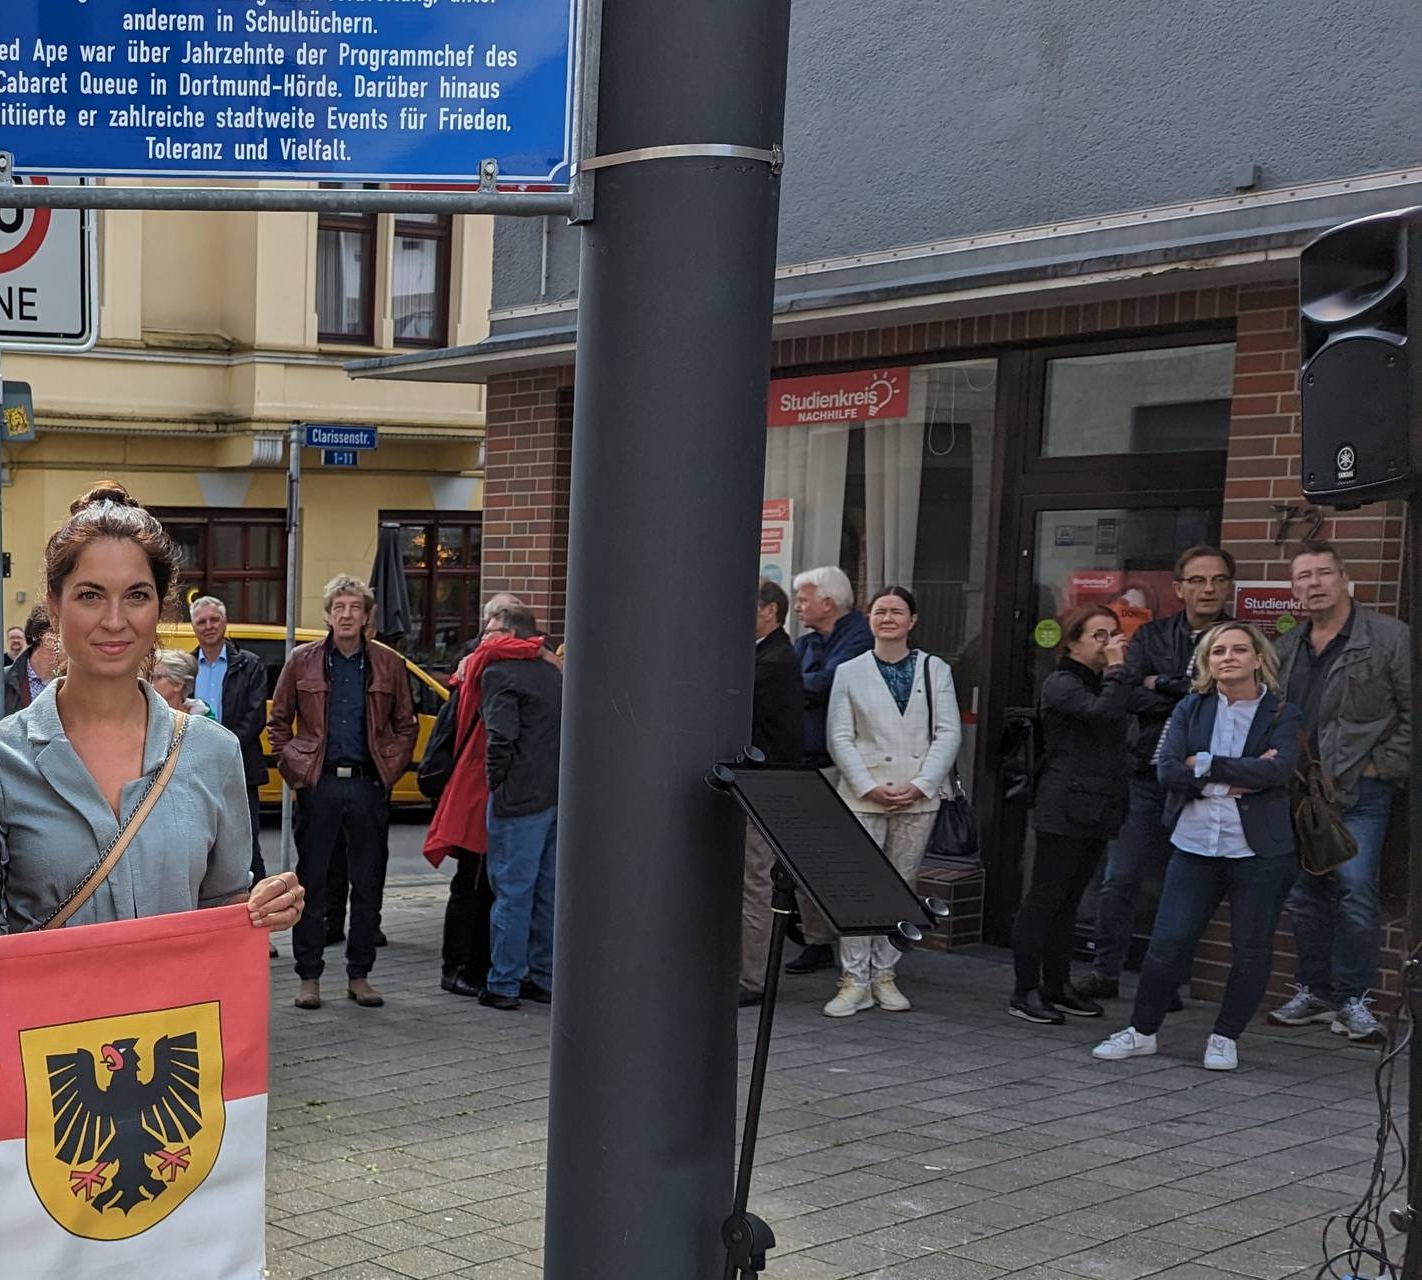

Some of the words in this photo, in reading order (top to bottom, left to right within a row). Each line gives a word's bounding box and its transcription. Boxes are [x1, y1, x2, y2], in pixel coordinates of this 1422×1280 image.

[123, 9, 204, 32] anderem
[217, 9, 233, 32] in
[245, 9, 378, 34] Schulbüchern.
[32, 38, 68, 68] Ape
[79, 45, 116, 62] war
[127, 39, 171, 63] über
[181, 40, 285, 65] Jahrzehnte
[296, 42, 328, 66] der
[339, 42, 475, 72] Programmchef
[485, 44, 518, 68] des
[80, 71, 138, 95] Queue
[150, 72, 167, 96] in
[179, 72, 342, 98] Dortmund-Hörde.
[354, 74, 429, 98] Darüber
[439, 75, 500, 99] hinaus
[78, 109, 98, 127] er
[109, 104, 205, 128] zahlreiche
[216, 105, 315, 129] stadtweite
[327, 106, 388, 130] Events
[399, 107, 428, 130] für
[439, 107, 511, 132] Frieden,
[145, 136, 223, 160] Toleranz
[234, 137, 268, 160] und
[280, 138, 351, 161] Vielfalt.
[780, 387, 878, 411] Studienkreis
[798, 408, 858, 422] NACHHILFE
[312, 428, 370, 445] Clarissenstr.
[1244, 597, 1306, 611] Studienkr
